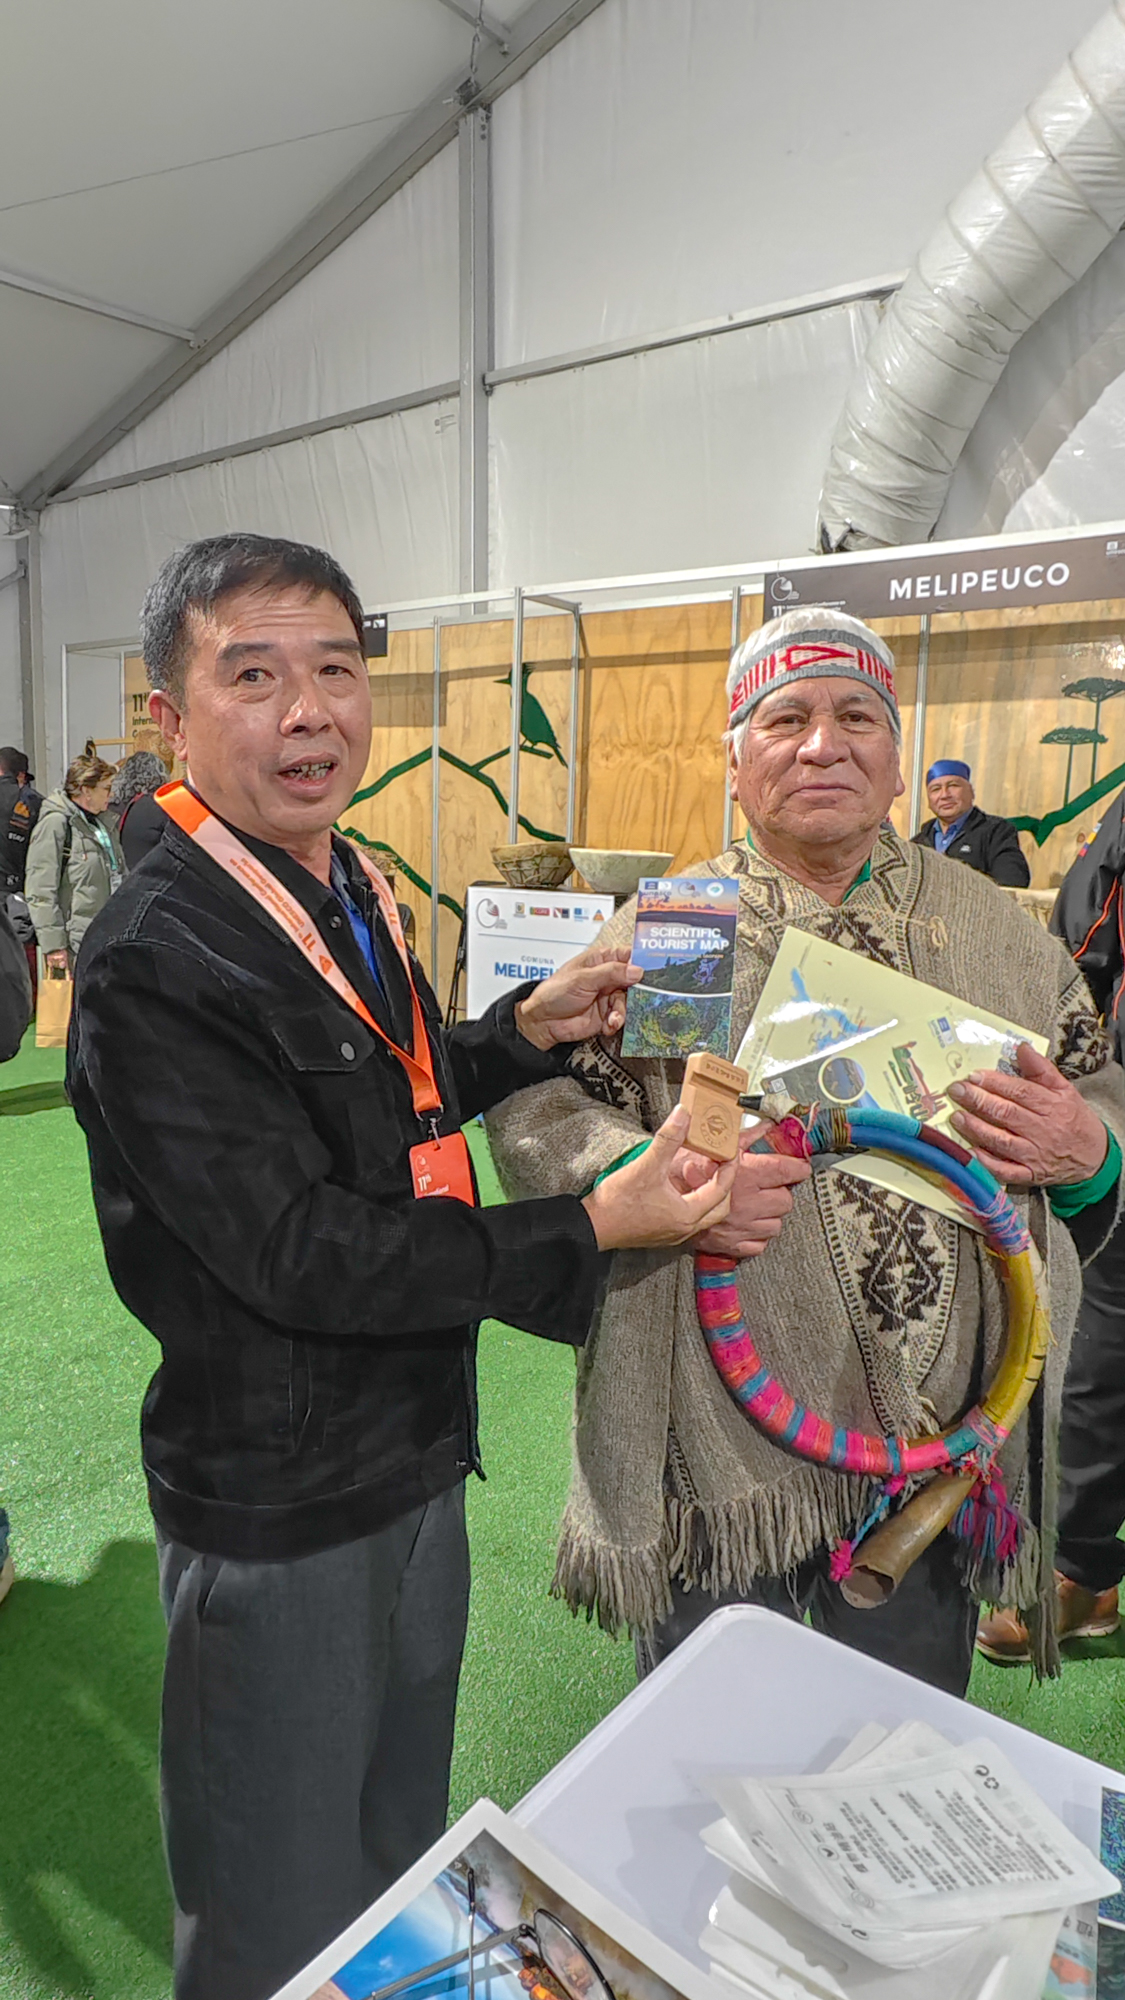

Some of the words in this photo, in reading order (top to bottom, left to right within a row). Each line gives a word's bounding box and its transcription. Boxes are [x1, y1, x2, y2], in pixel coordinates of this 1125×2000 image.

[889, 562, 1070, 601] MELIPEUCO
[650, 926, 722, 939] SCIENTIFIC
[640, 938, 698, 950] TOURIST
[699, 940, 730, 951] MAP
[520, 955, 555, 965] COMUNA
